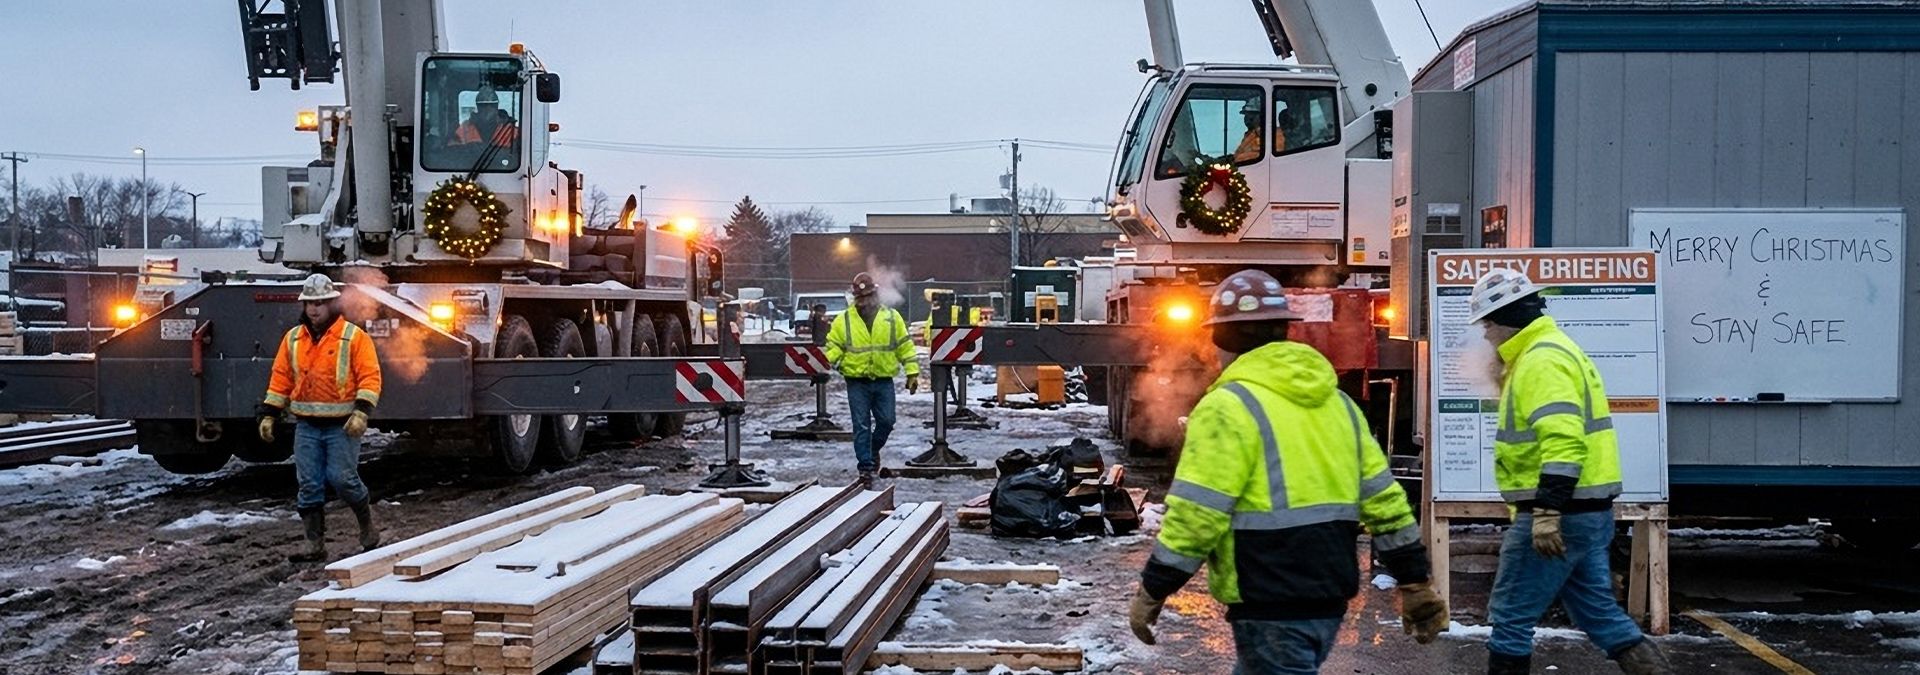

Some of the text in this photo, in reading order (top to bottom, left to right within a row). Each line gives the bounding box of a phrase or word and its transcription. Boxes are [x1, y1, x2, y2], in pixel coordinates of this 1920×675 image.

[1539, 257, 1648, 280] BRIEFING
[1650, 227, 1893, 270] MERRY CHRISTMAS
[1690, 311, 1847, 353] STAY SAFE
